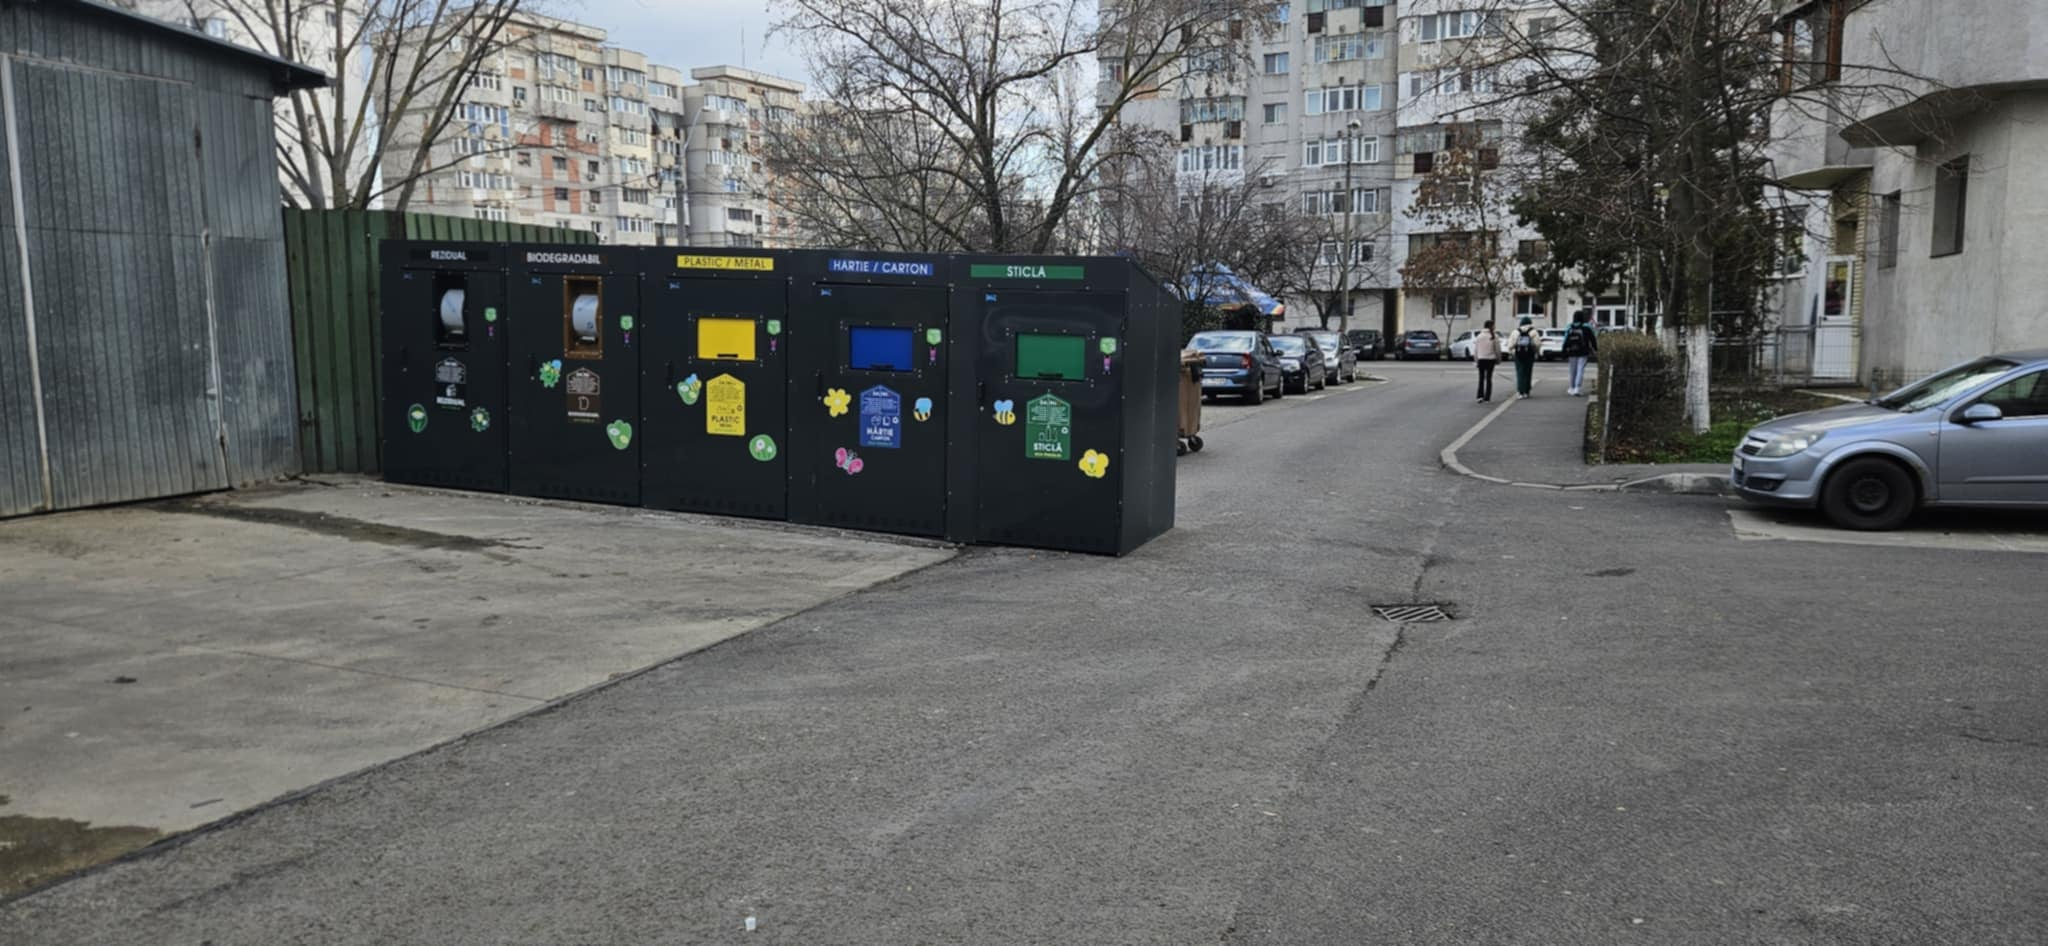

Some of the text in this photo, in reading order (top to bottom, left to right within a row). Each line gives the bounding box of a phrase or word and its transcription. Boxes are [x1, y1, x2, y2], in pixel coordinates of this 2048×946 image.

[430, 250, 467, 261] REZIDUAL
[526, 252, 602, 265] BIODEGRADABIL
[684, 257, 722, 268] PLASTIC
[734, 258, 768, 269] METAL
[833, 260, 869, 272] HARTIE
[881, 262, 928, 275] CARTON
[1007, 265, 1046, 278] STICLA
